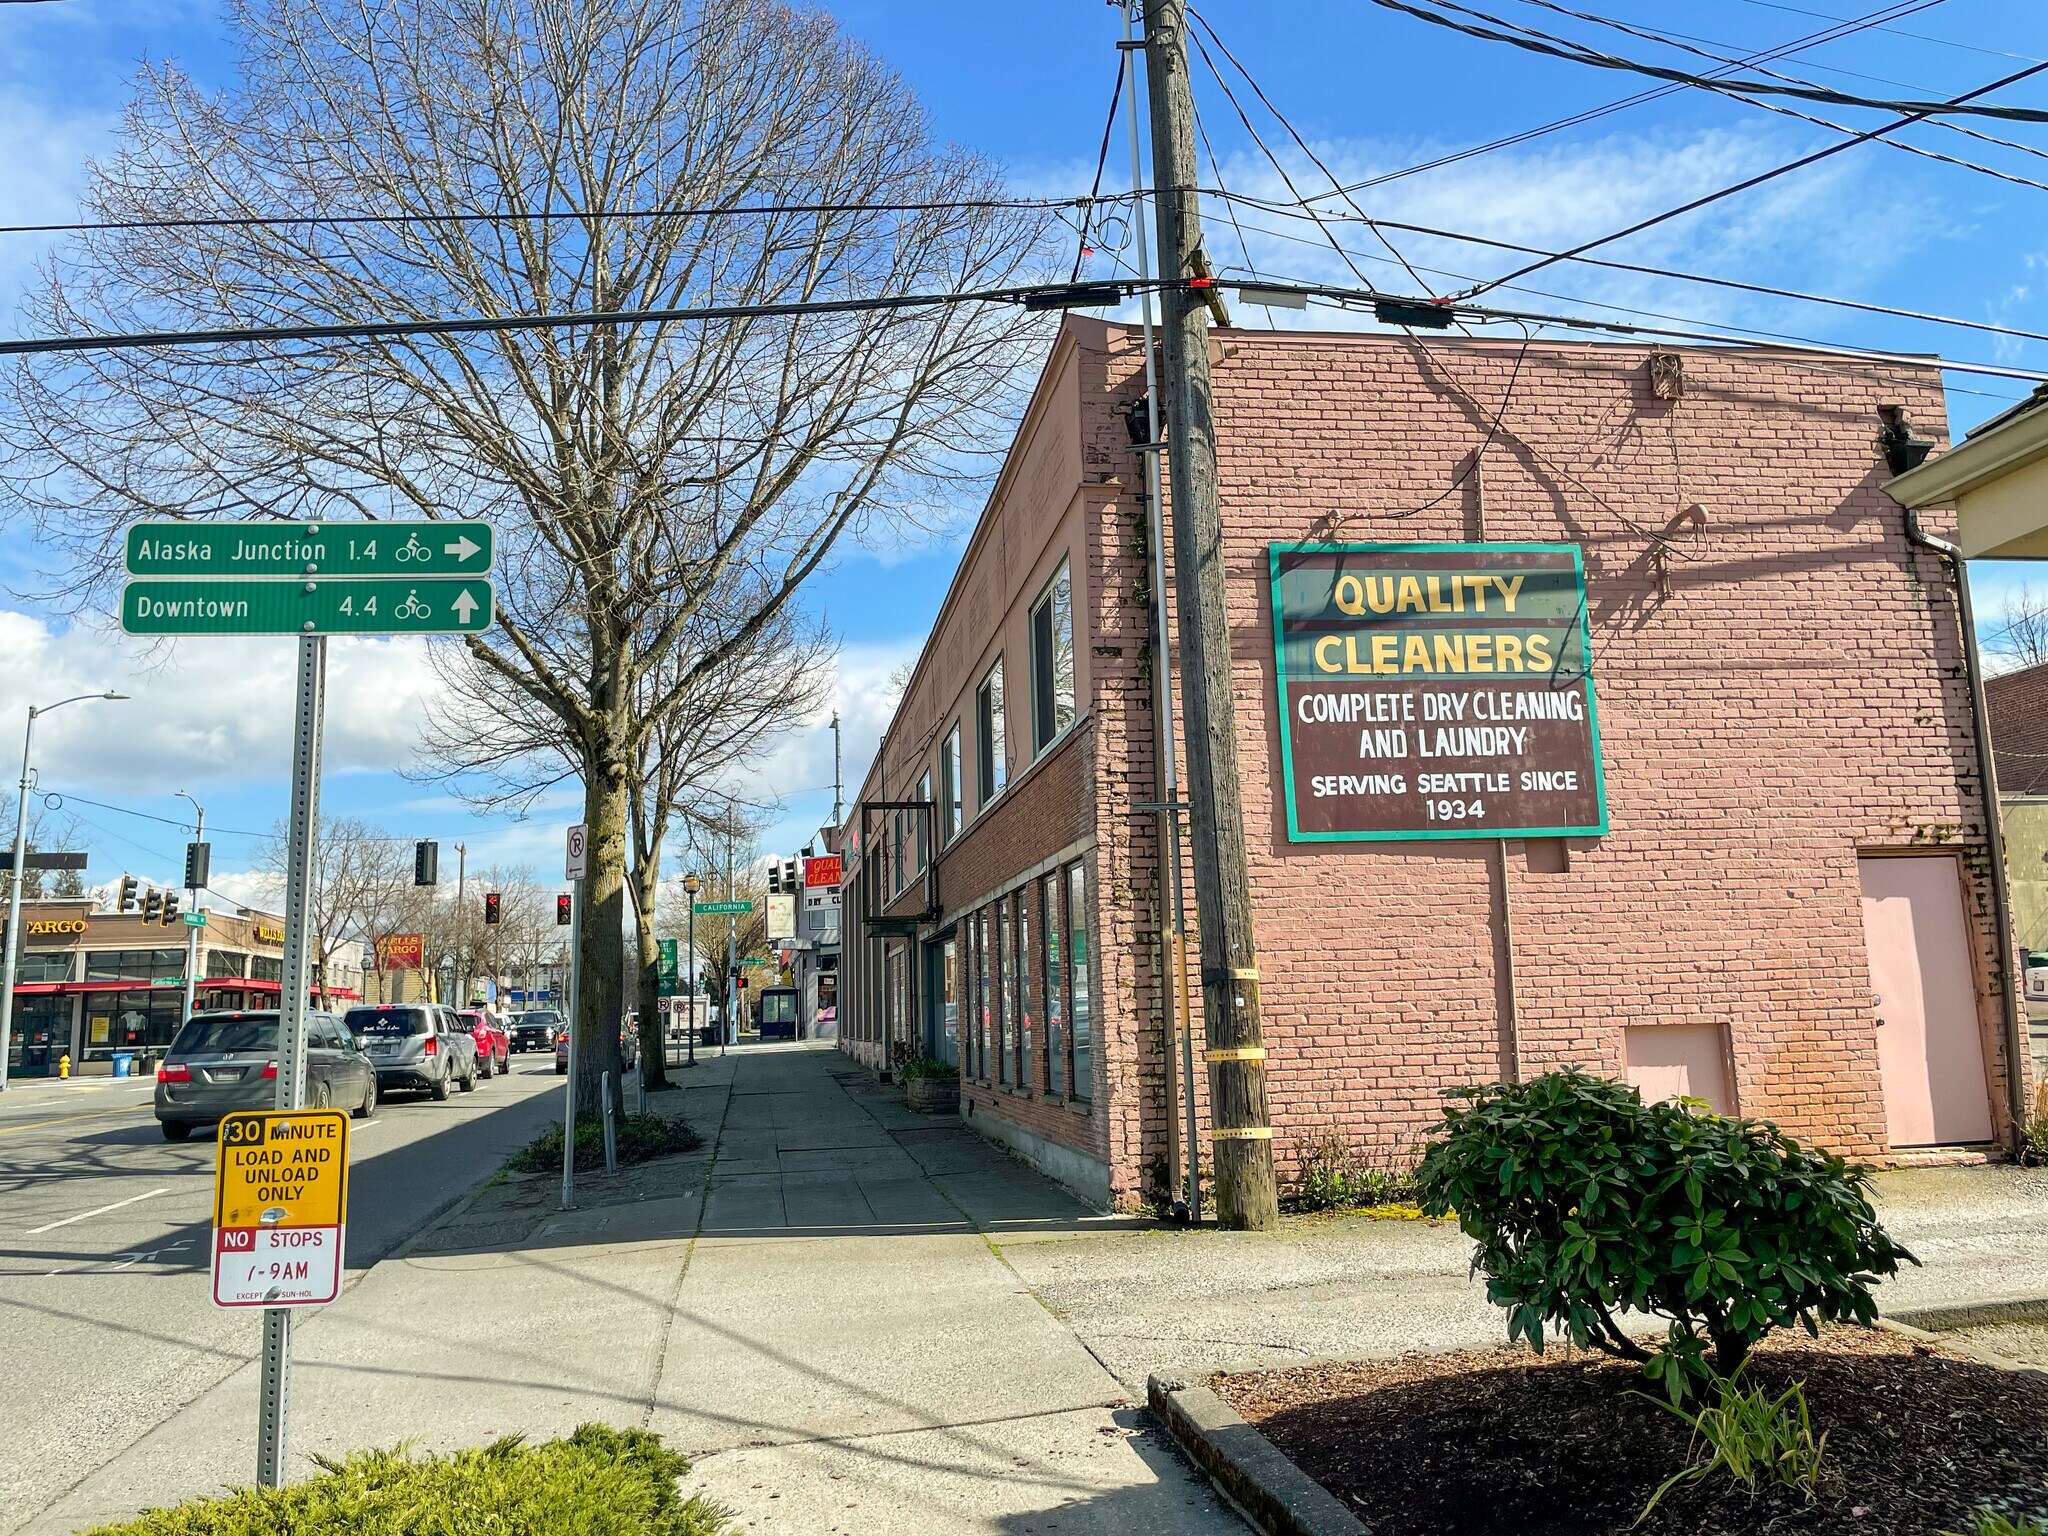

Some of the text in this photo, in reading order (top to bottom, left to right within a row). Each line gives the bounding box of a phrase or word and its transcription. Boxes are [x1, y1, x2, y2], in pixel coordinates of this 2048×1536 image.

[138, 540, 377, 561] Alaska Junction 1.4
[1334, 575, 1524, 616] QUALITY
[137, 596, 377, 618] Downtown 4.4
[1314, 634, 1553, 673] CLEANERS
[1298, 690, 1584, 723] COMPLETE DRY CLEANING
[1360, 726, 1527, 758] AND LAUNDRY
[1311, 770, 1578, 797] SERVING SEATTLE SINCE
[1426, 799, 1485, 820] 1934
[259, 926, 277, 940] WELLS
[229, 1120, 261, 1142] 30
[236, 1148, 330, 1166] LOAD AND
[245, 1167, 319, 1183] UNLOAD
[258, 1186, 304, 1201] ONLY
[224, 1231, 322, 1247] NO STOPS
[282, 1290, 313, 1298] SUN-HOL
